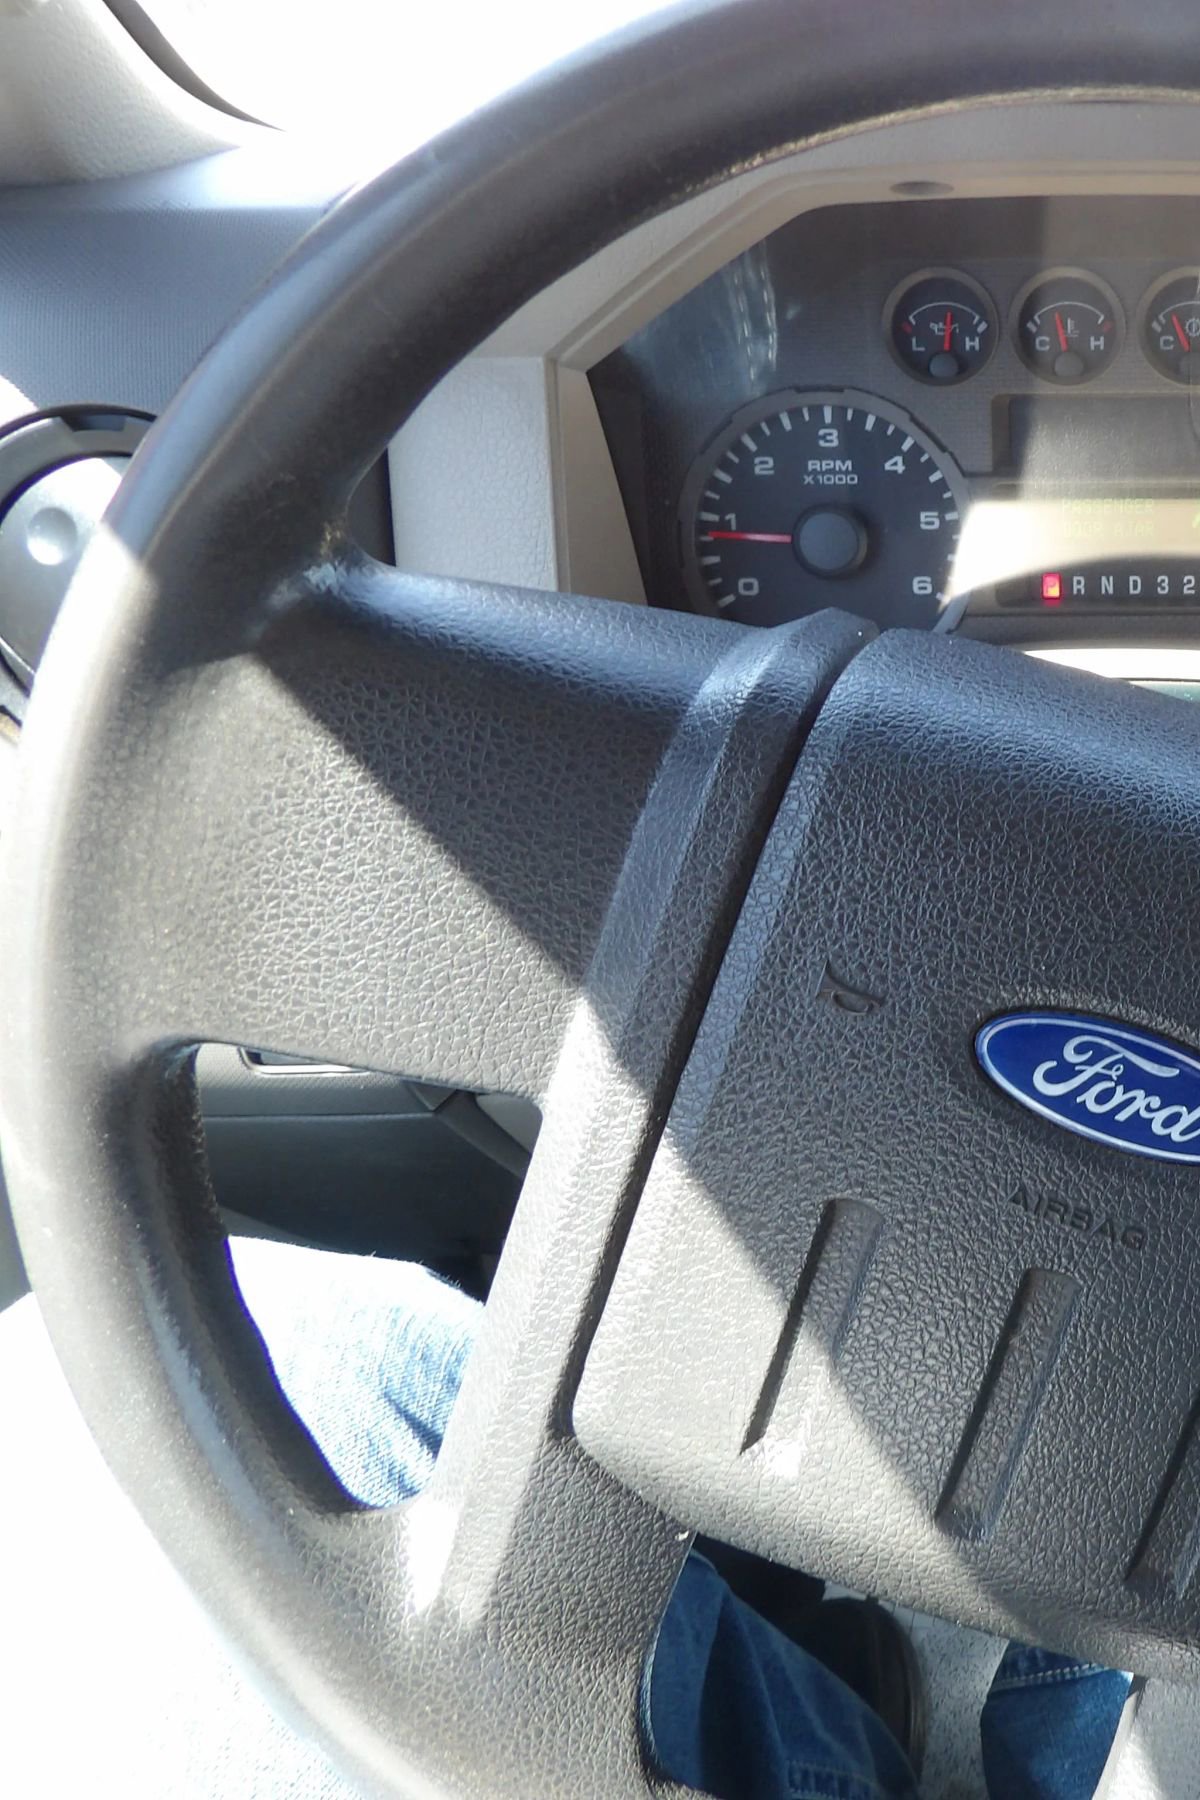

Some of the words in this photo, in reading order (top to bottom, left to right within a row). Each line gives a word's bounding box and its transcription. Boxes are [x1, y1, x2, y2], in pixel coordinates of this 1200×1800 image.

[911, 338, 925, 351] L
[964, 338, 981, 351] H
[1035, 338, 1050, 351] C
[1090, 338, 1105, 351] H
[1159, 337, 1175, 350] C
[817, 428, 839, 448] 3
[753, 456, 775, 476] 2
[807, 460, 853, 472] RPM
[884, 455, 906, 474] 4
[803, 474, 858, 485] X1000
[725, 513, 737, 531] 1
[919, 511, 940, 530] 5
[738, 578, 759, 596] 0
[912, 576, 933, 595] 6
[1072, 576, 1086, 594] R
[1101, 576, 1114, 594] N
[1129, 576, 1142, 594] D
[1156, 576, 1170, 594] 3
[1182, 576, 1196, 594] 2
[1006, 1183, 1146, 1250] AIRBAG
